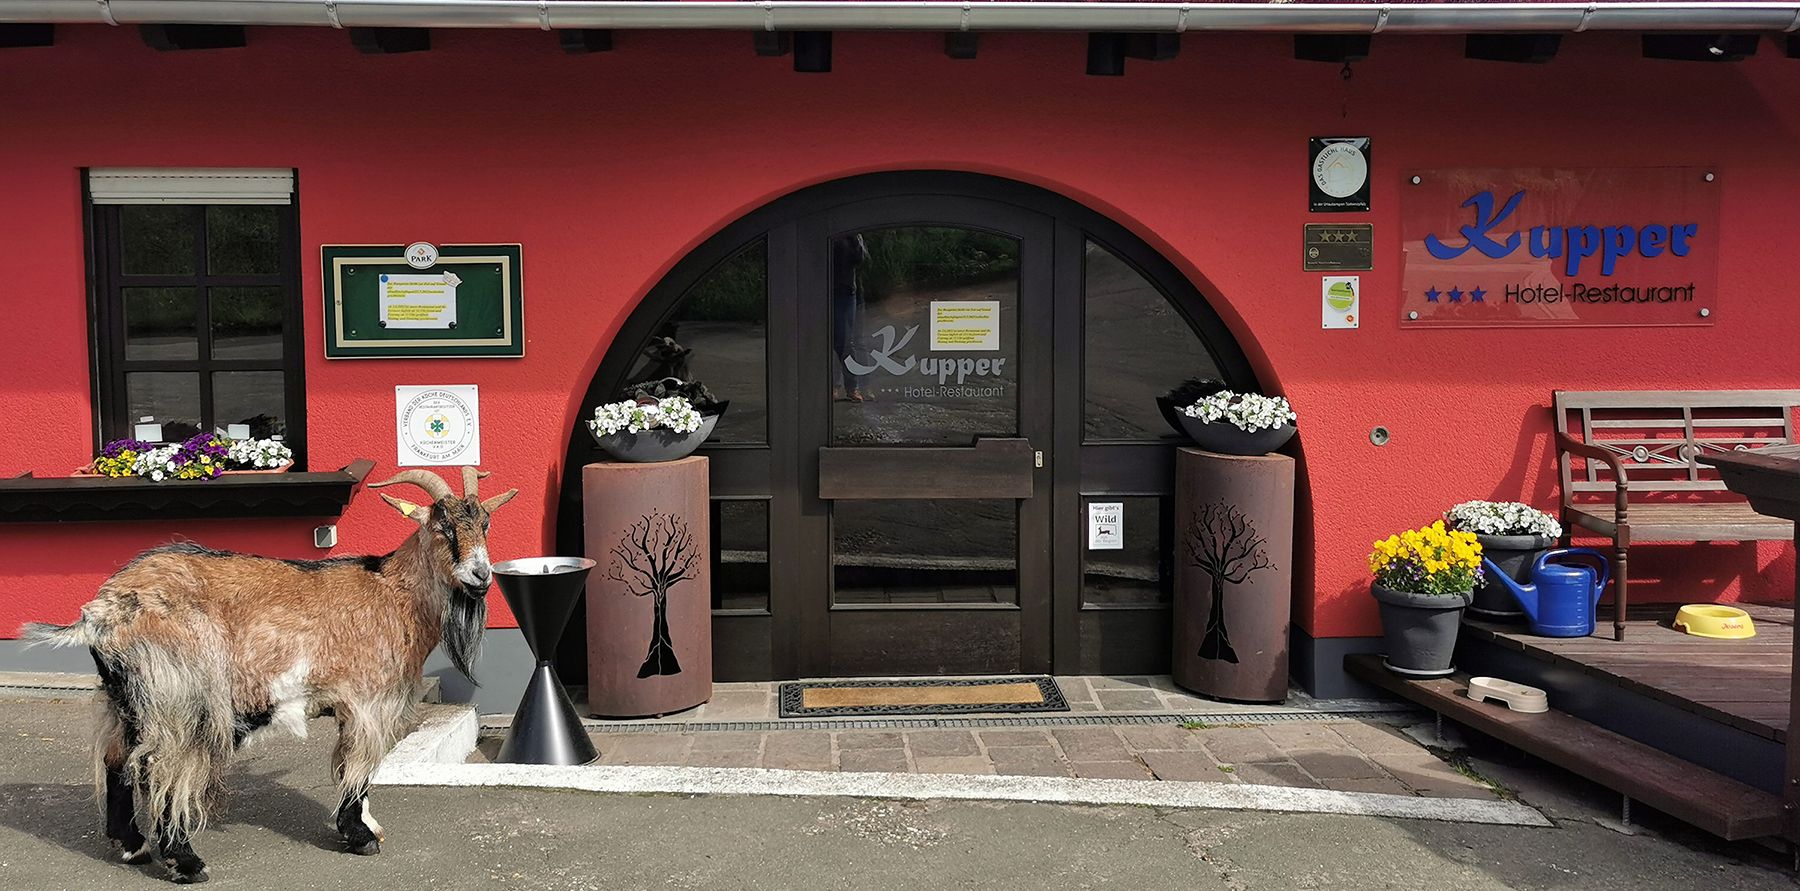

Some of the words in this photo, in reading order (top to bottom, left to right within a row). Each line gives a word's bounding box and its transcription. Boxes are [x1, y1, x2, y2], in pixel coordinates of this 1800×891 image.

[1316, 147, 1339, 173] GASTLICHE
[1340, 147, 1356, 156] HAUS
[1317, 173, 1327, 186] DAS
[1424, 189, 1698, 277] Kupper
[1505, 282, 1695, 303] Hotel-Restaurant
[844, 324, 1006, 384] Kupper
[904, 385, 1004, 398] Hotel-Restaurant
[403, 405, 414, 427] VERBAND
[412, 397, 421, 406] DER
[439, 392, 470, 416] DEUTSCHLANDS
[411, 444, 440, 460] FRANKFURT
[452, 444, 464, 455] MAIN
[1095, 515, 1117, 523] Wild
